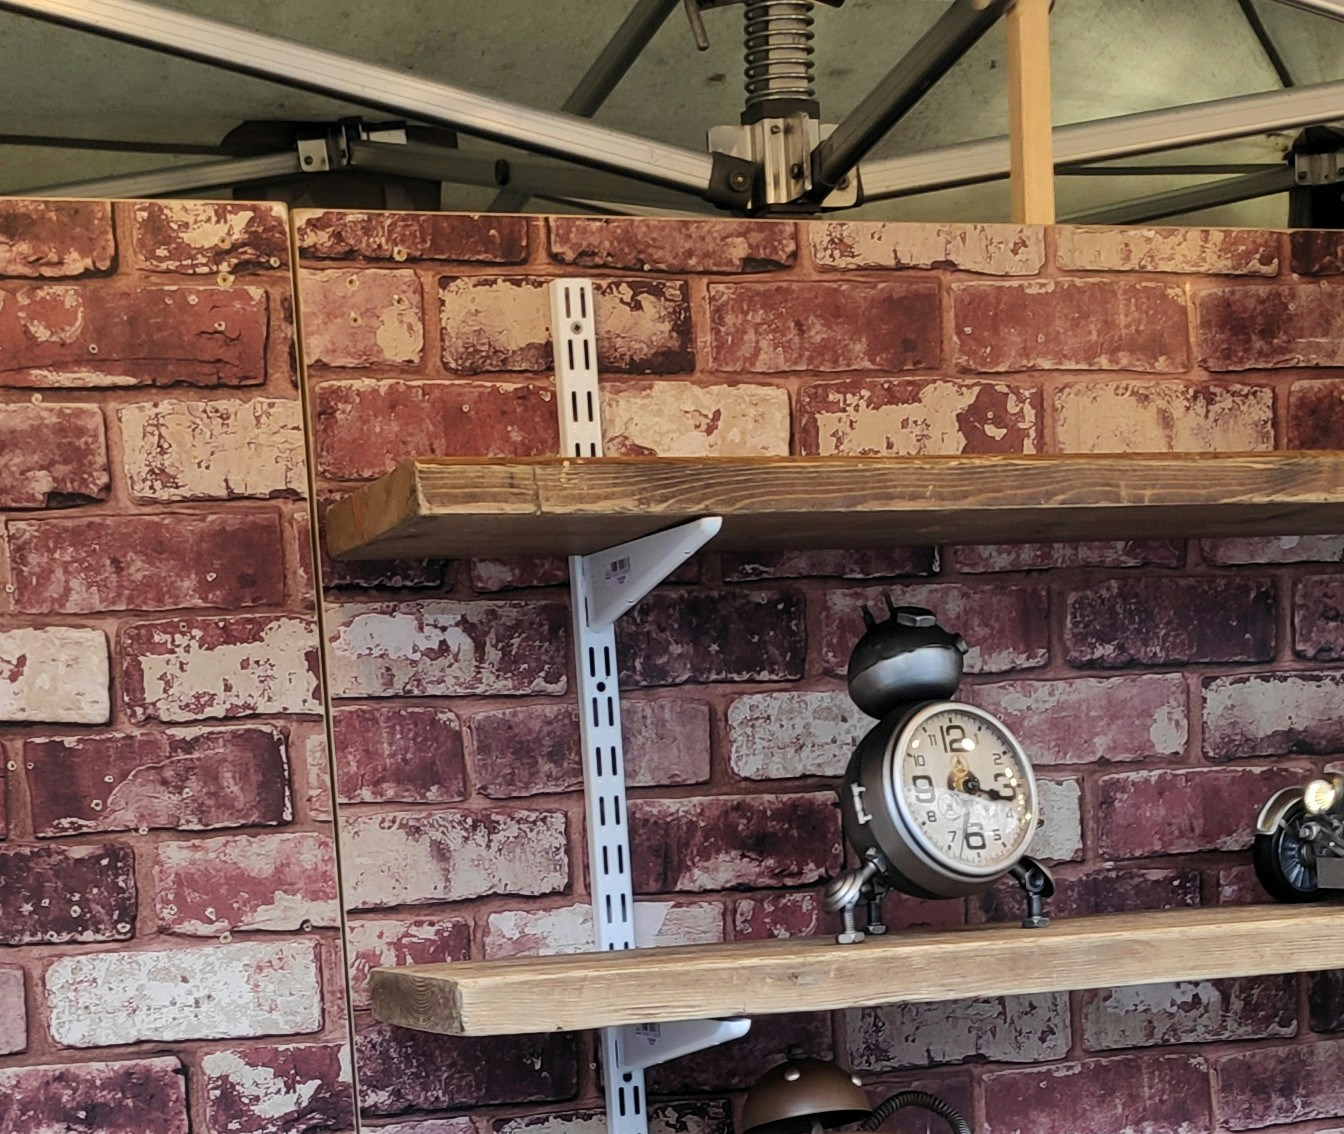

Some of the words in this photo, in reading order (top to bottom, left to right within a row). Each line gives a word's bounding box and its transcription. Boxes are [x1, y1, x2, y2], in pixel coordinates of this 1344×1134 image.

[928, 734, 937, 746] 11
[940, 724, 973, 753] 12
[912, 754, 926, 767] 10
[992, 753, 1003, 765] 2
[912, 775, 936, 804] 9
[926, 810, 937, 822] 8
[948, 831, 957, 843] 7
[965, 822, 987, 850] 6
